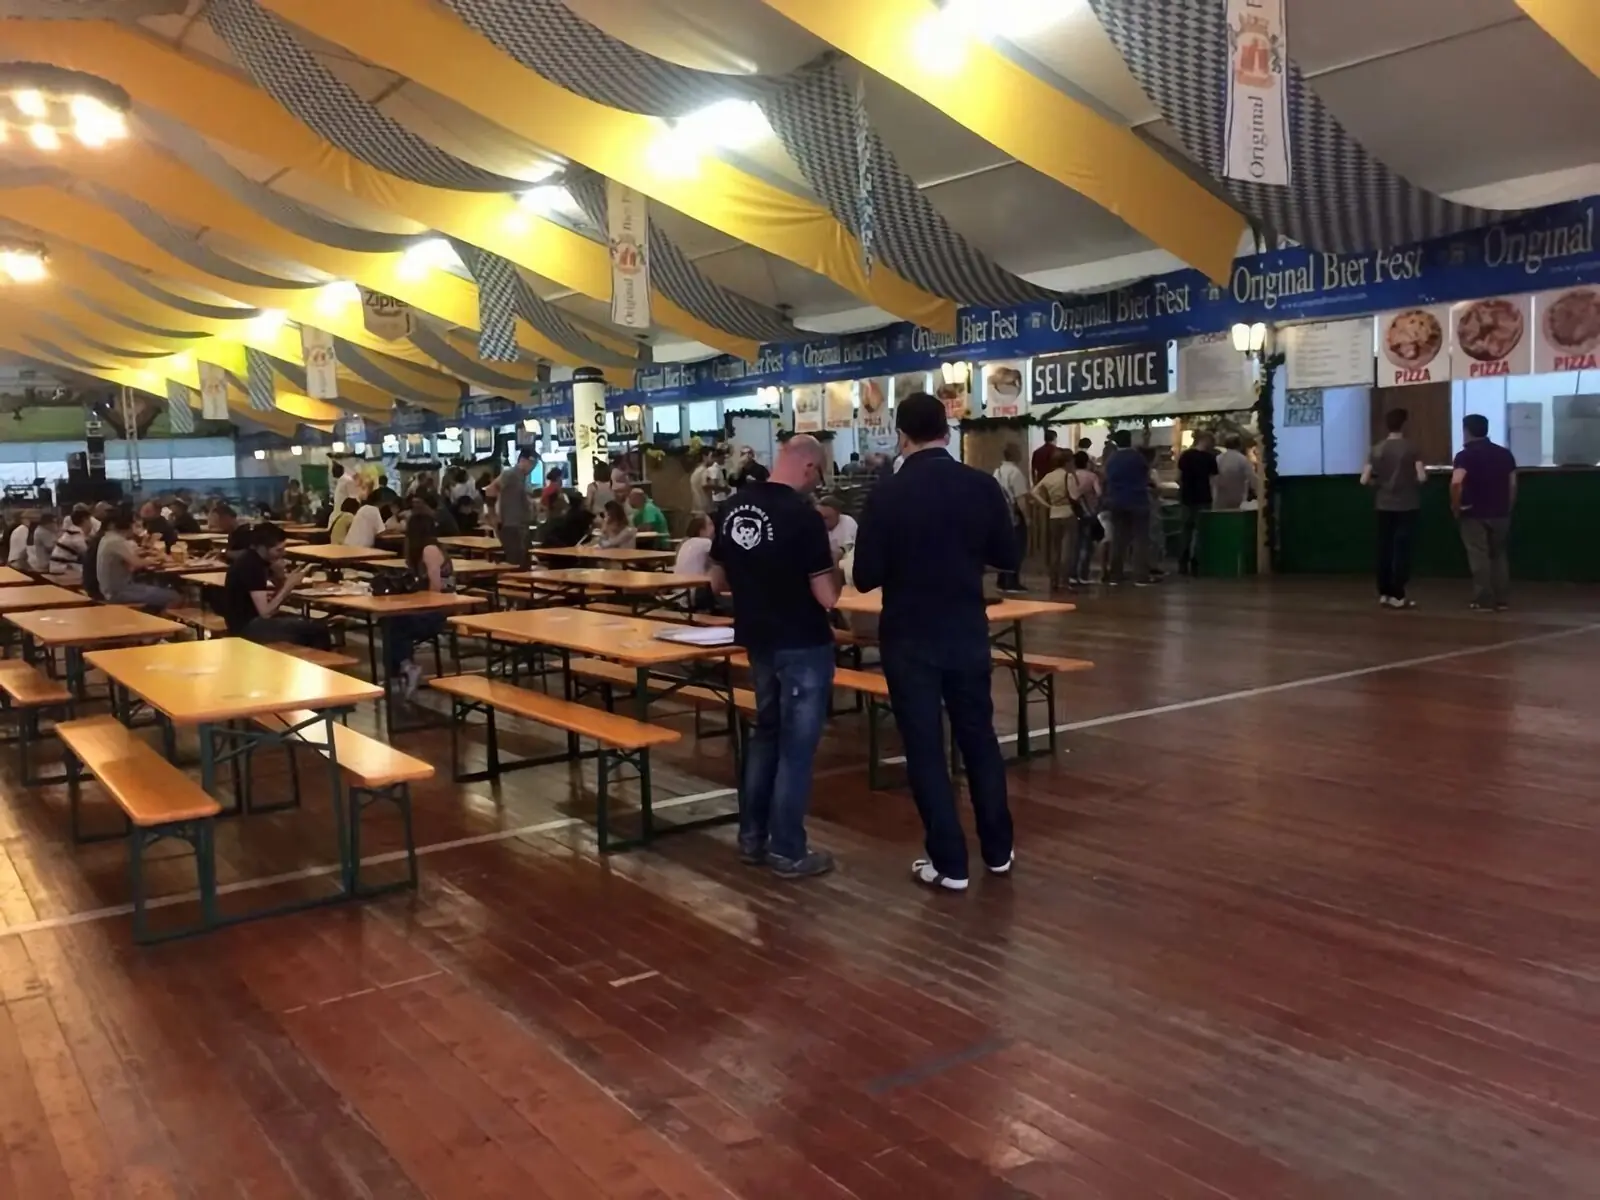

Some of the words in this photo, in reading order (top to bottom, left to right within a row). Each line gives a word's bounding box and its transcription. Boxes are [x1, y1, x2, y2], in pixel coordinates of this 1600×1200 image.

[1248, 95, 1268, 179] Original
[1484, 207, 1594, 274] Original
[1233, 253, 1315, 309] Original
[1323, 252, 1369, 290] Bier
[1373, 247, 1424, 284] Fest
[962, 313, 989, 345] Bier
[991, 310, 1019, 341] Fest
[1051, 291, 1112, 338] Original
[1116, 288, 1150, 322] Bier
[1155, 281, 1192, 317] Fest
[1035, 361, 1077, 396] SELF
[1081, 352, 1158, 391] SERVICE
[1394, 367, 1431, 384] PIZZA
[1469, 361, 1511, 377] PIZZA
[1554, 354, 1597, 371] PIZZA
